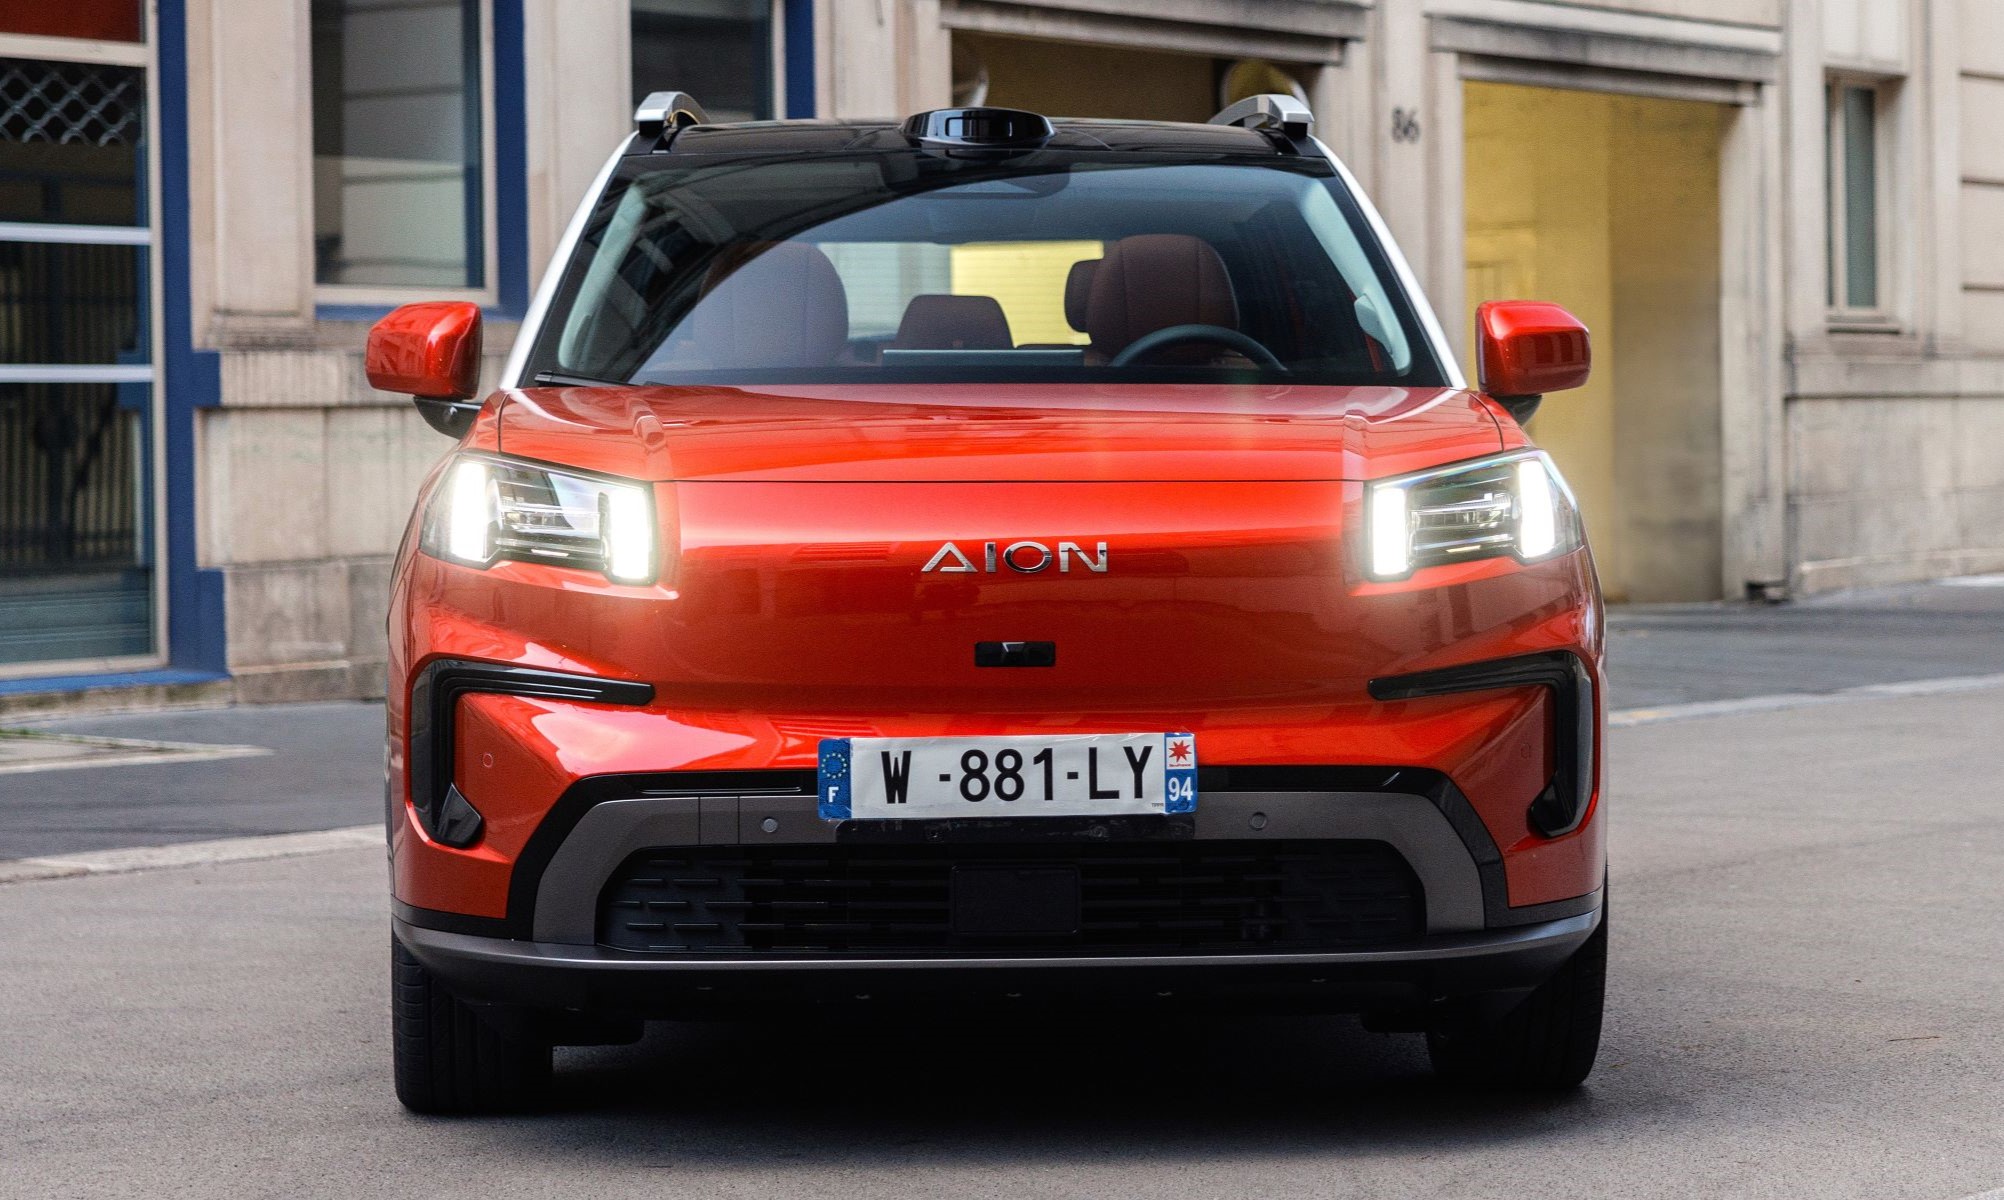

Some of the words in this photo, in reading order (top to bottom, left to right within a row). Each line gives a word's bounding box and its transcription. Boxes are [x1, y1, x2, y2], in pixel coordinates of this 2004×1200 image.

[1391, 106, 1420, 143] 86
[921, 541, 1108, 573] AION
[881, 751, 911, 804] W
[1168, 776, 1193, 801] 94
[828, 786, 839, 803] F
